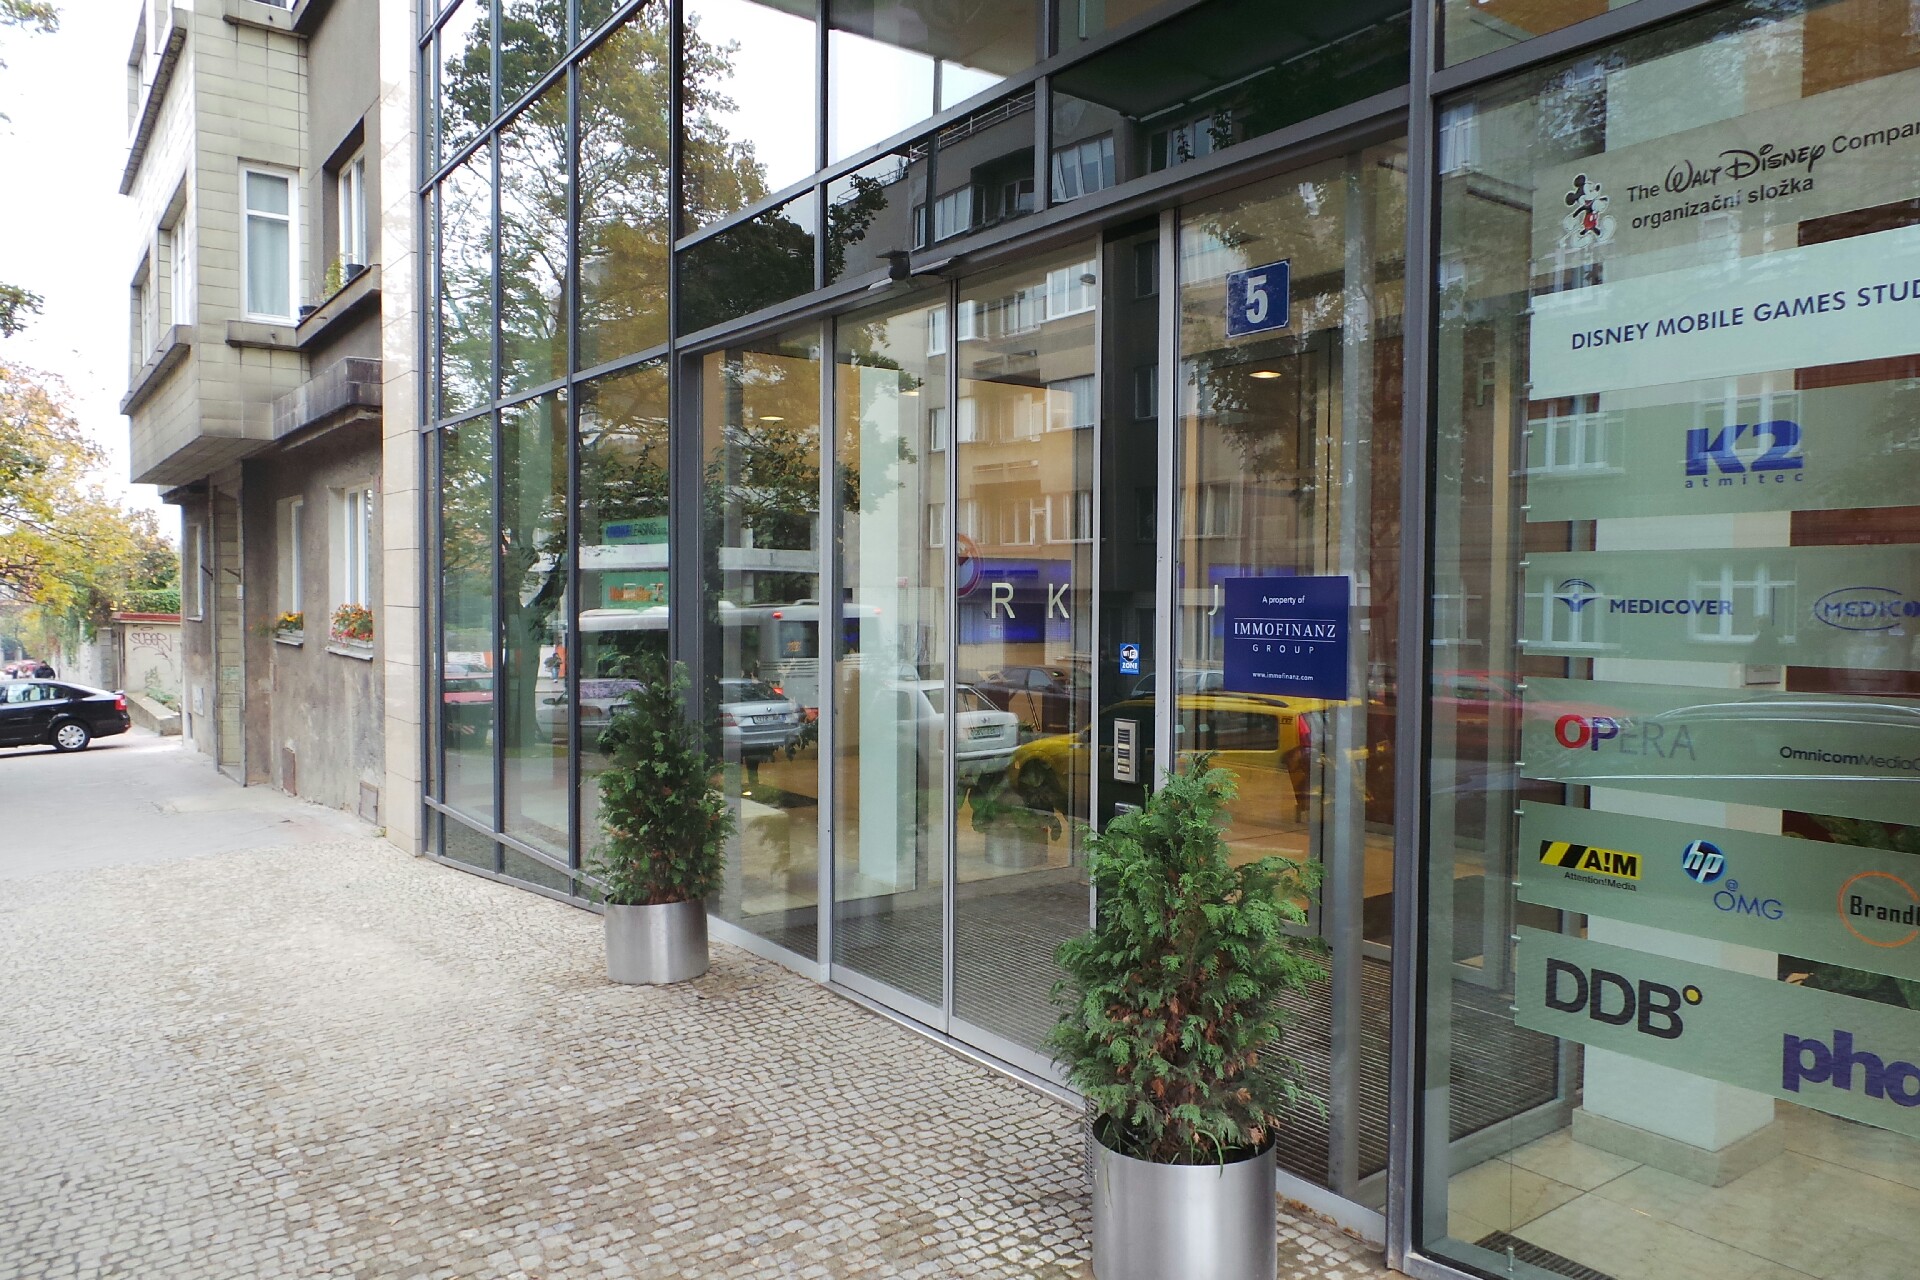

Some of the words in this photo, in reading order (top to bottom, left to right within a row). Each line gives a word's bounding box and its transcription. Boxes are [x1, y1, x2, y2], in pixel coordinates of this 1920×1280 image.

[1627, 184, 1660, 202] The
[1832, 121, 1920, 156] Compa
[1631, 189, 1741, 229] organizační
[1747, 175, 1814, 204] složka
[1246, 274, 1269, 324] 5
[1571, 322, 1650, 350] DISNEY
[1655, 307, 1744, 338] MOBILE
[1753, 290, 1846, 322] GAMES
[1685, 420, 1803, 476] K2
[1685, 472, 1803, 489] atmitec
[1262, 595, 1268, 603] A
[1268, 596, 1297, 605] property
[1297, 595, 1306, 604] of
[1609, 599, 1734, 616] MEDICOVER
[1234, 622, 1336, 638] IMMOFINANZ
[1252, 644, 1315, 654] GROUP
[1121, 662, 1138, 670] ZONE
[1252, 671, 1314, 681] www.immofinanz.com
[1554, 713, 1696, 761] OPERA
[1683, 839, 1724, 884] hp
[1564, 871, 1637, 892] Attention!Media
[1713, 890, 1784, 920] OMG
[1850, 894, 1920, 927] Brand
[1782, 1029, 1920, 1108] pho
